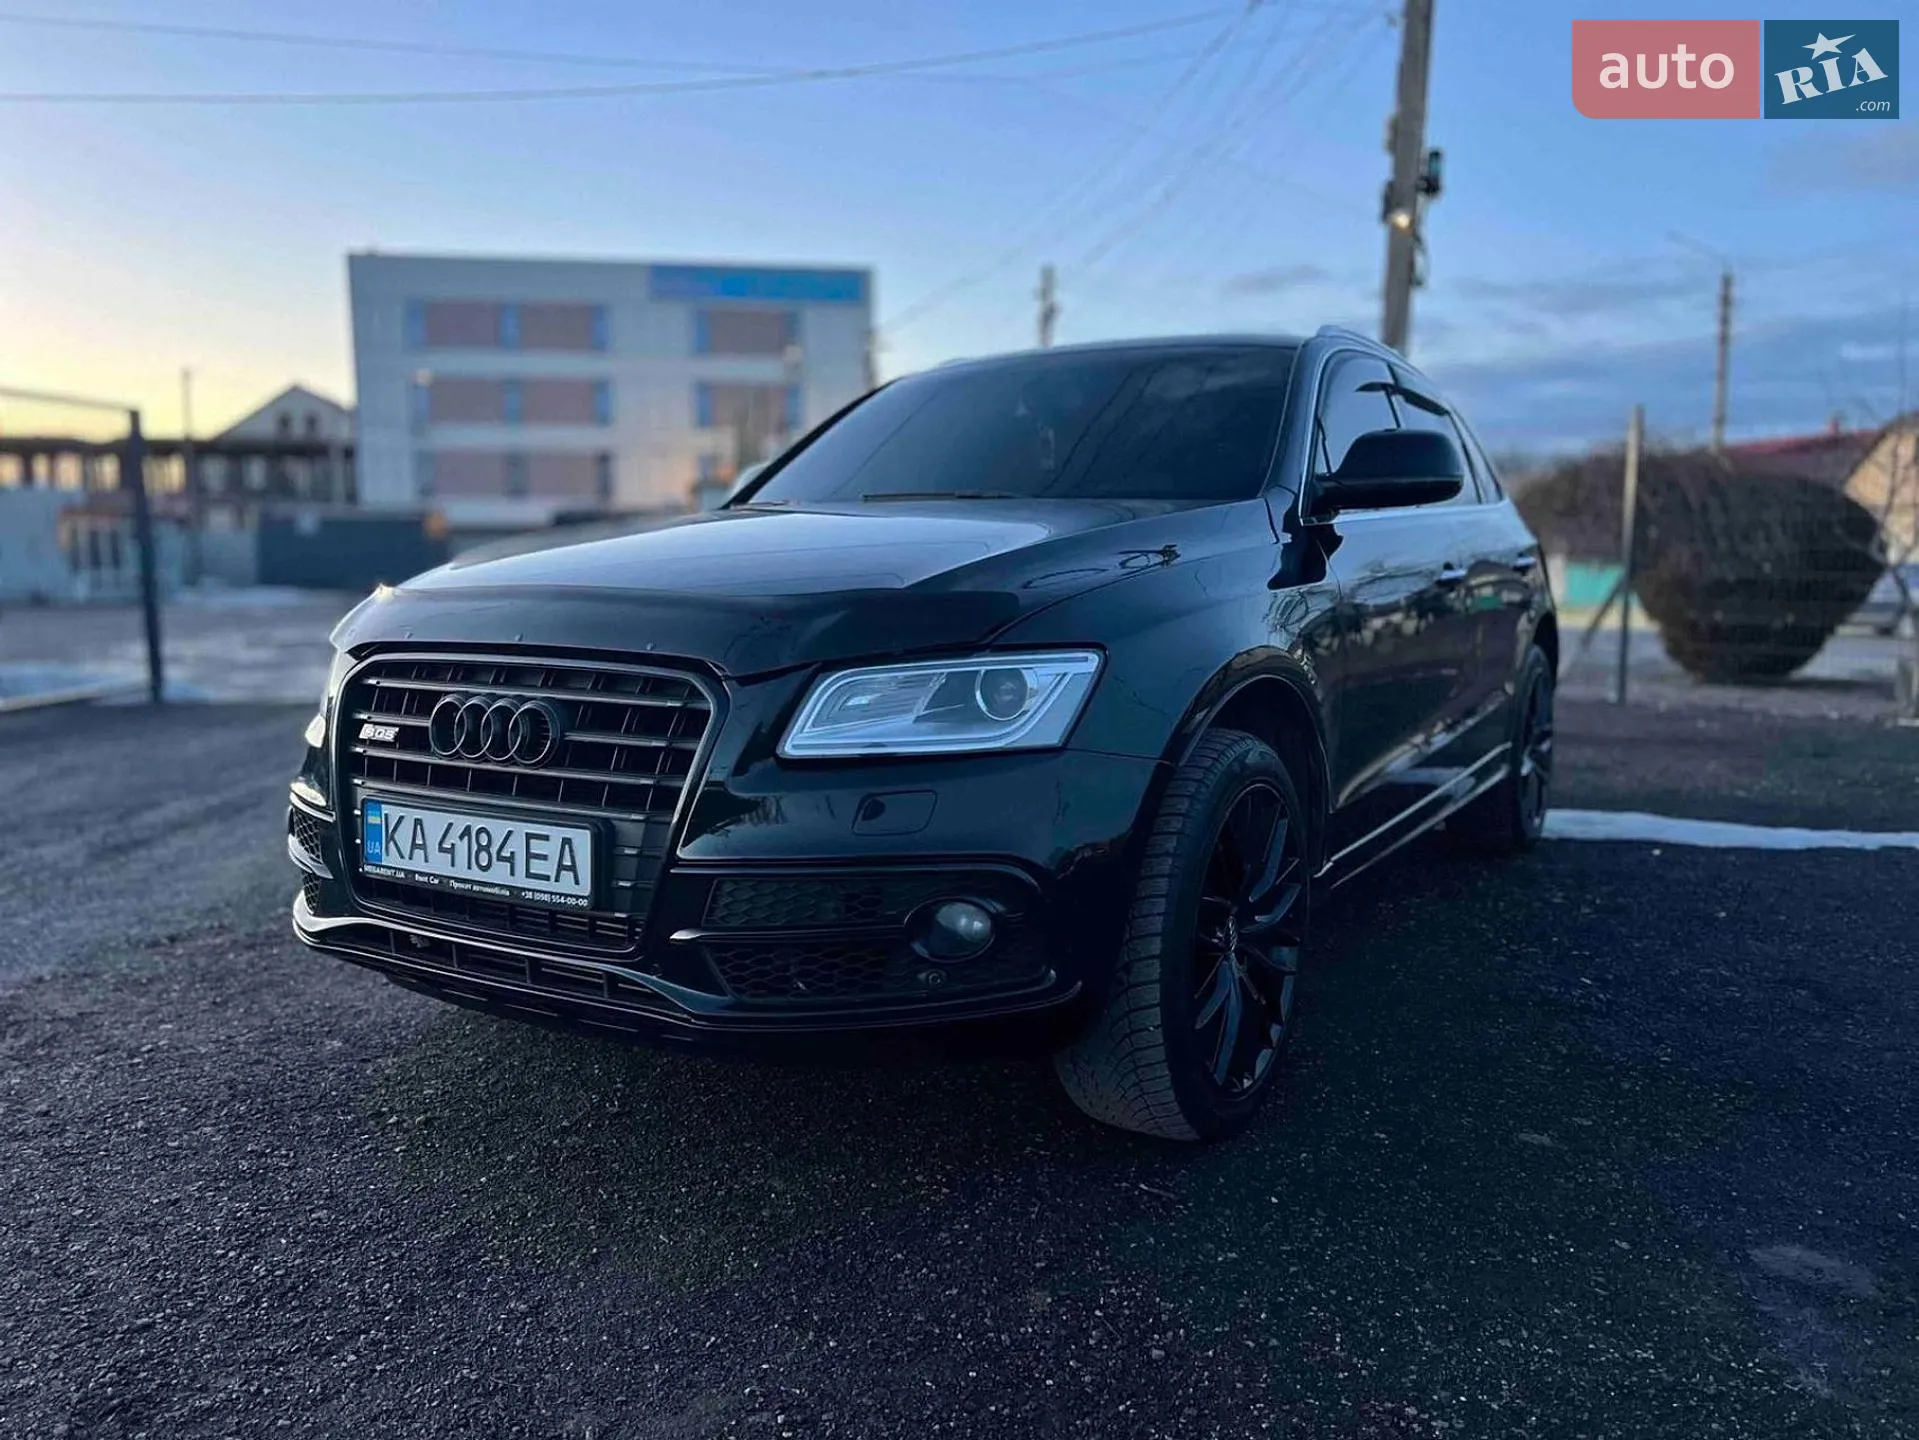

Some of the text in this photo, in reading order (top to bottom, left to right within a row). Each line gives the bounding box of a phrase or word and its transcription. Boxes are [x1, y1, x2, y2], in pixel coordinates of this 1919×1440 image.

[367, 839, 381, 856] UA
[384, 813, 581, 886] KA 4184 EA
